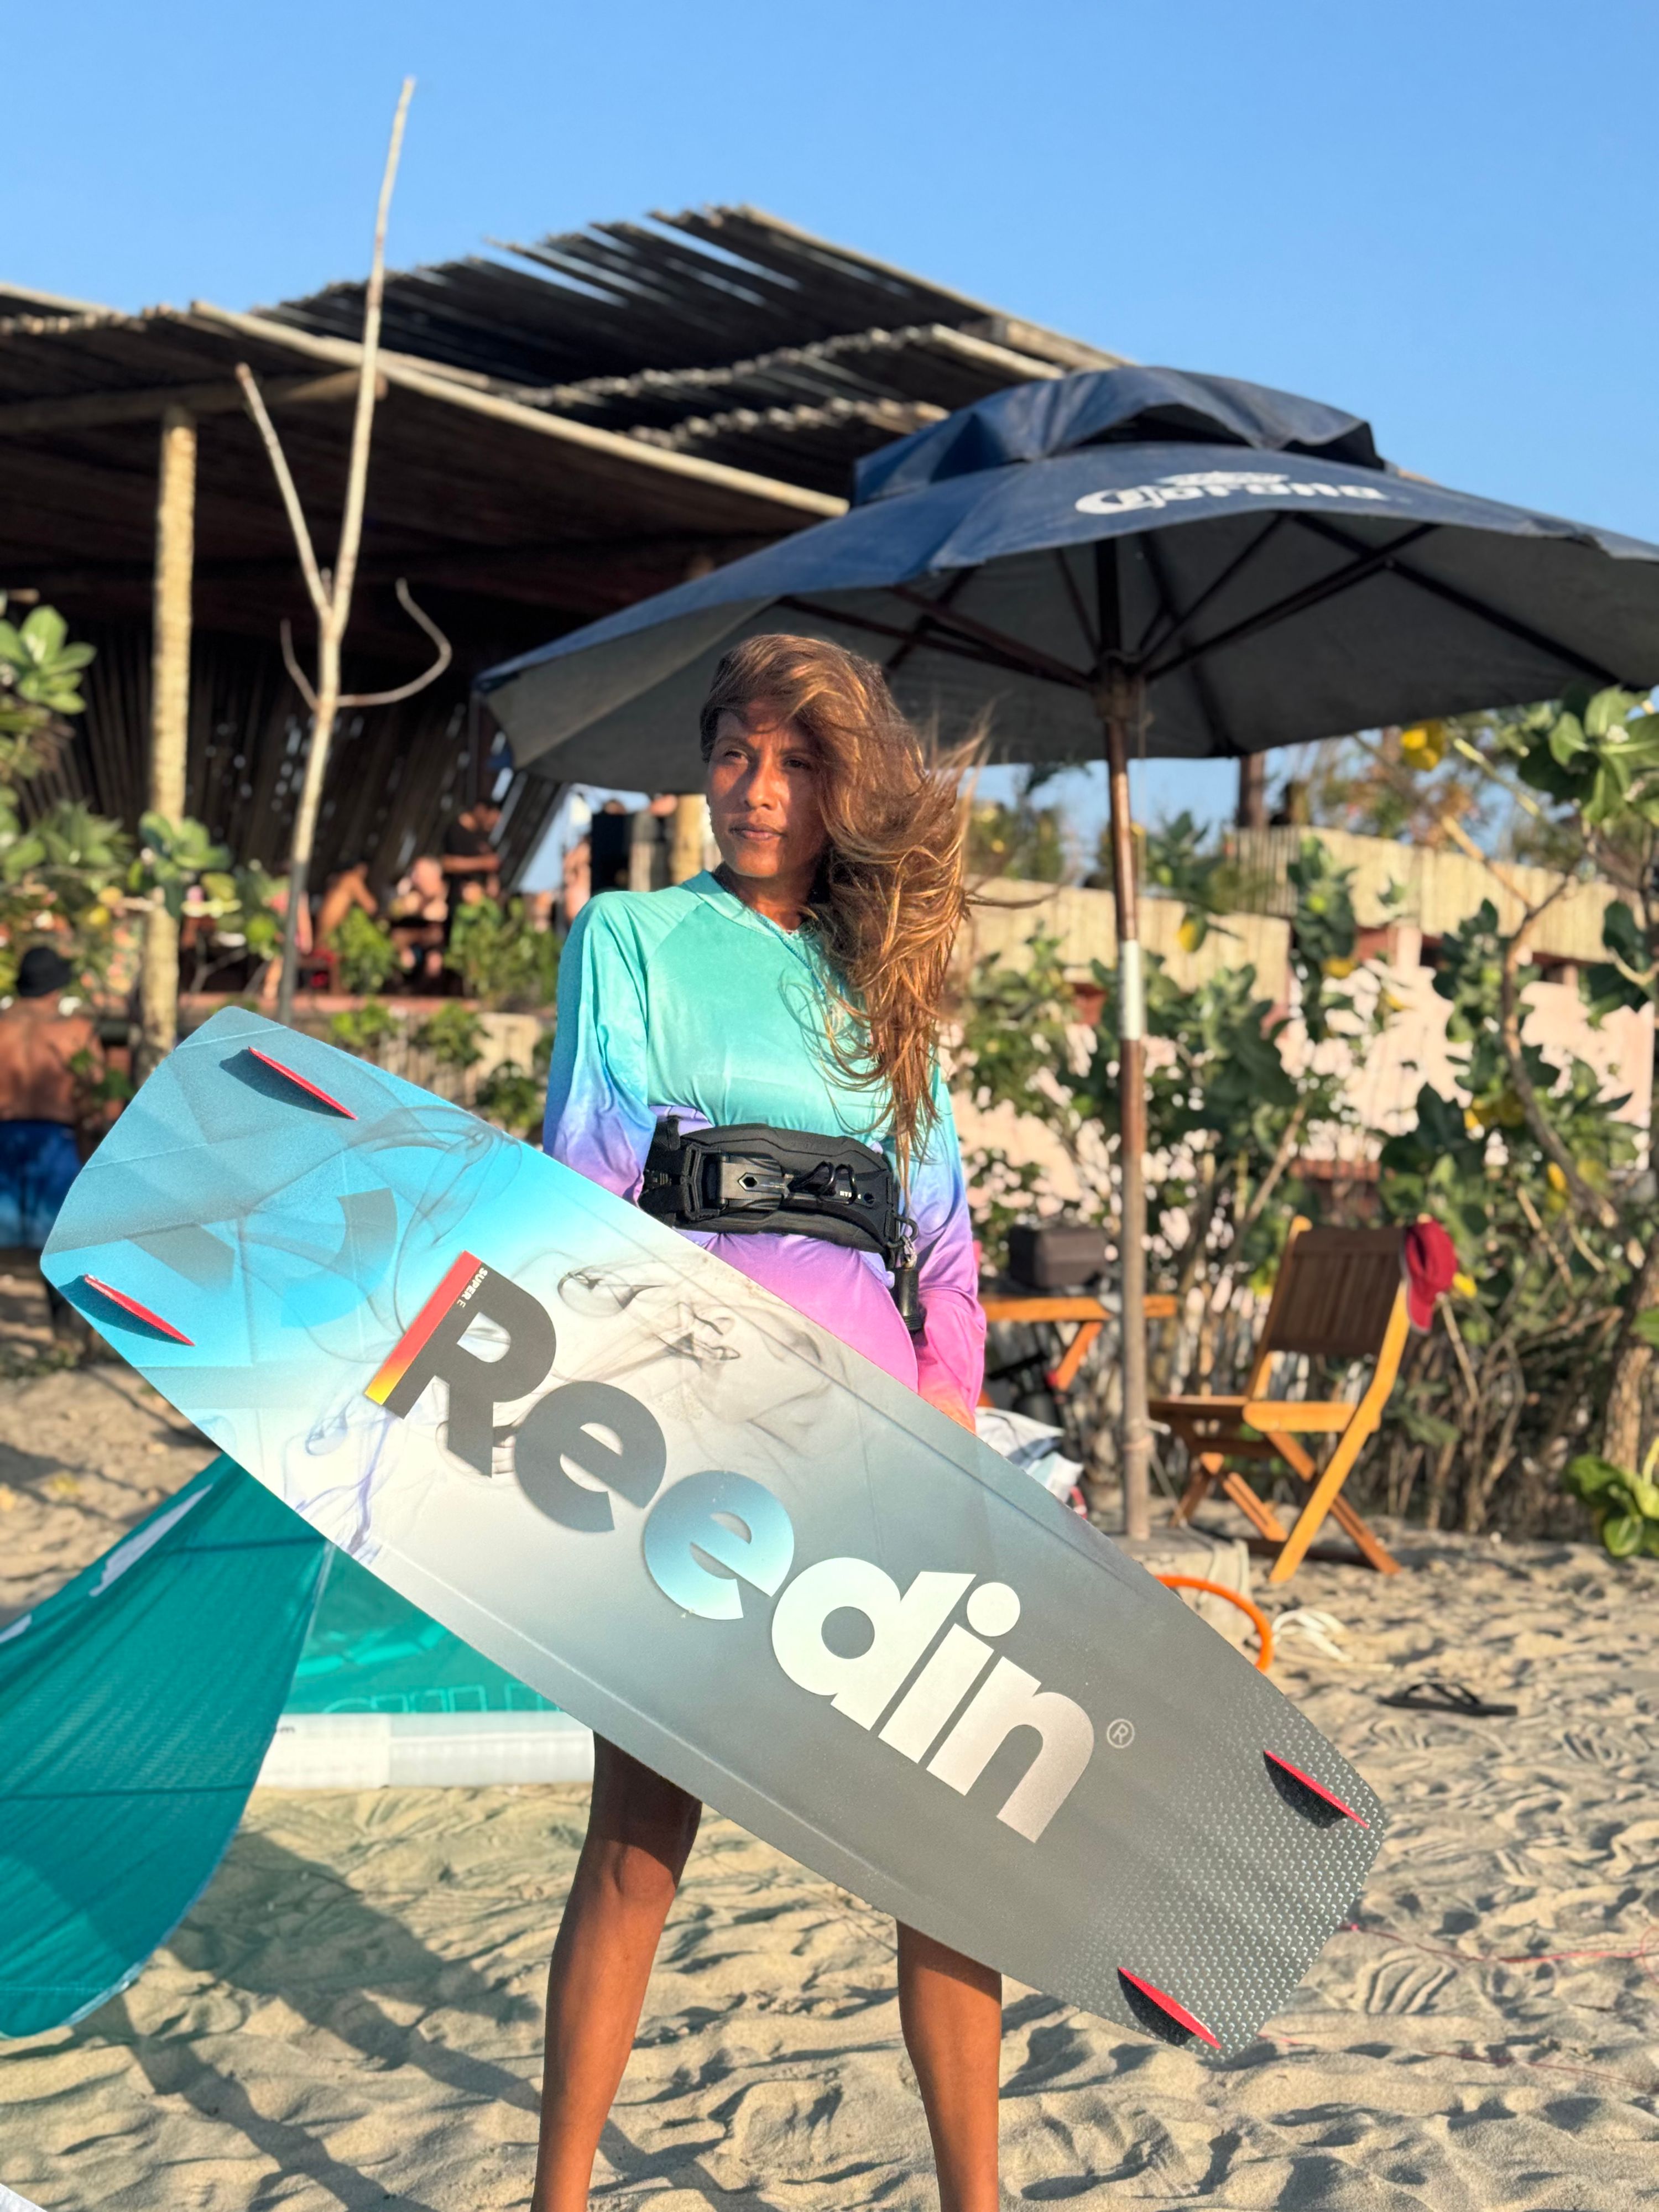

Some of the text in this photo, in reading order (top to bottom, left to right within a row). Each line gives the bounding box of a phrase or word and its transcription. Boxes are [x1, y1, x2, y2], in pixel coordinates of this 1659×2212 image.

[1075, 480, 1390, 515] Corona
[456, 1267, 488, 1308] SUPER E
[364, 1250, 1095, 1843] Reedin
